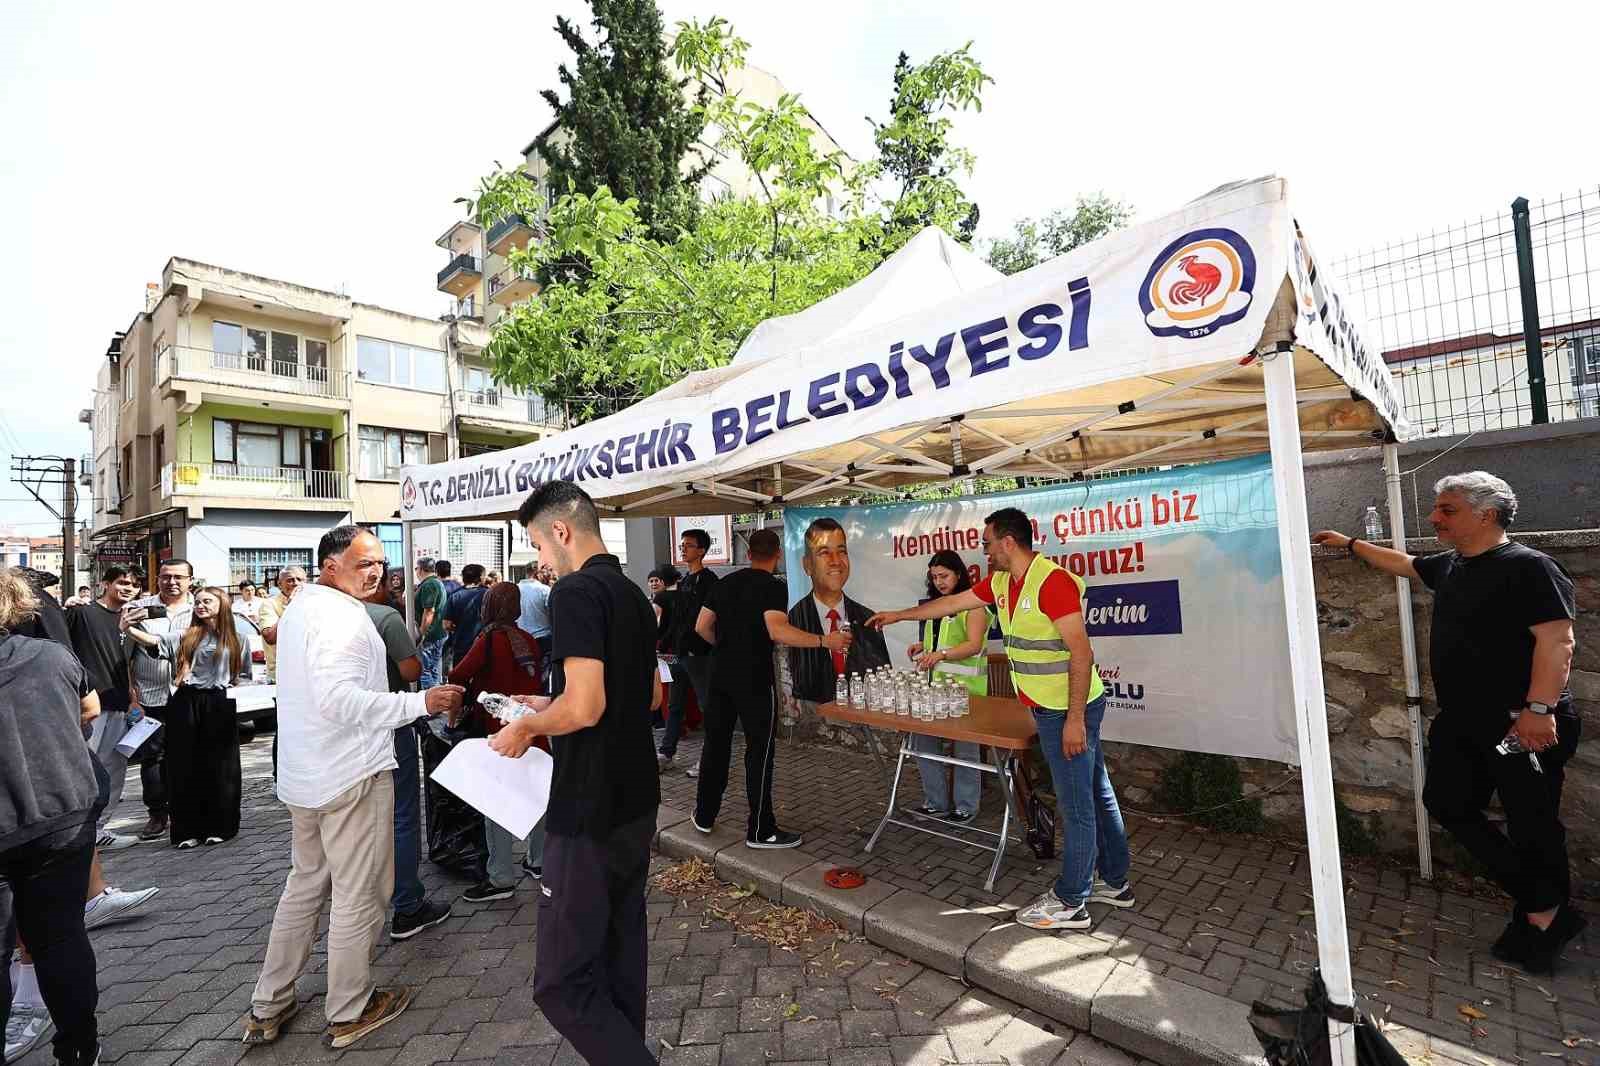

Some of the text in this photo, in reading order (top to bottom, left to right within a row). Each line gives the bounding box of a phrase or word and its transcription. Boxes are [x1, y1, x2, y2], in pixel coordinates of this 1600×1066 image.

[1189, 327, 1210, 337] 1876
[419, 480, 444, 506] T.C.
[446, 459, 515, 502] DENİZLİ
[516, 418, 696, 492] BÜYÜKŞEHİR
[712, 276, 1092, 455] BELEDİYESİ
[893, 526, 979, 559] Kendine
[1054, 496, 1143, 544] çünkü
[1152, 490, 1199, 526] biz
[1044, 542, 1144, 577] yoruz!
